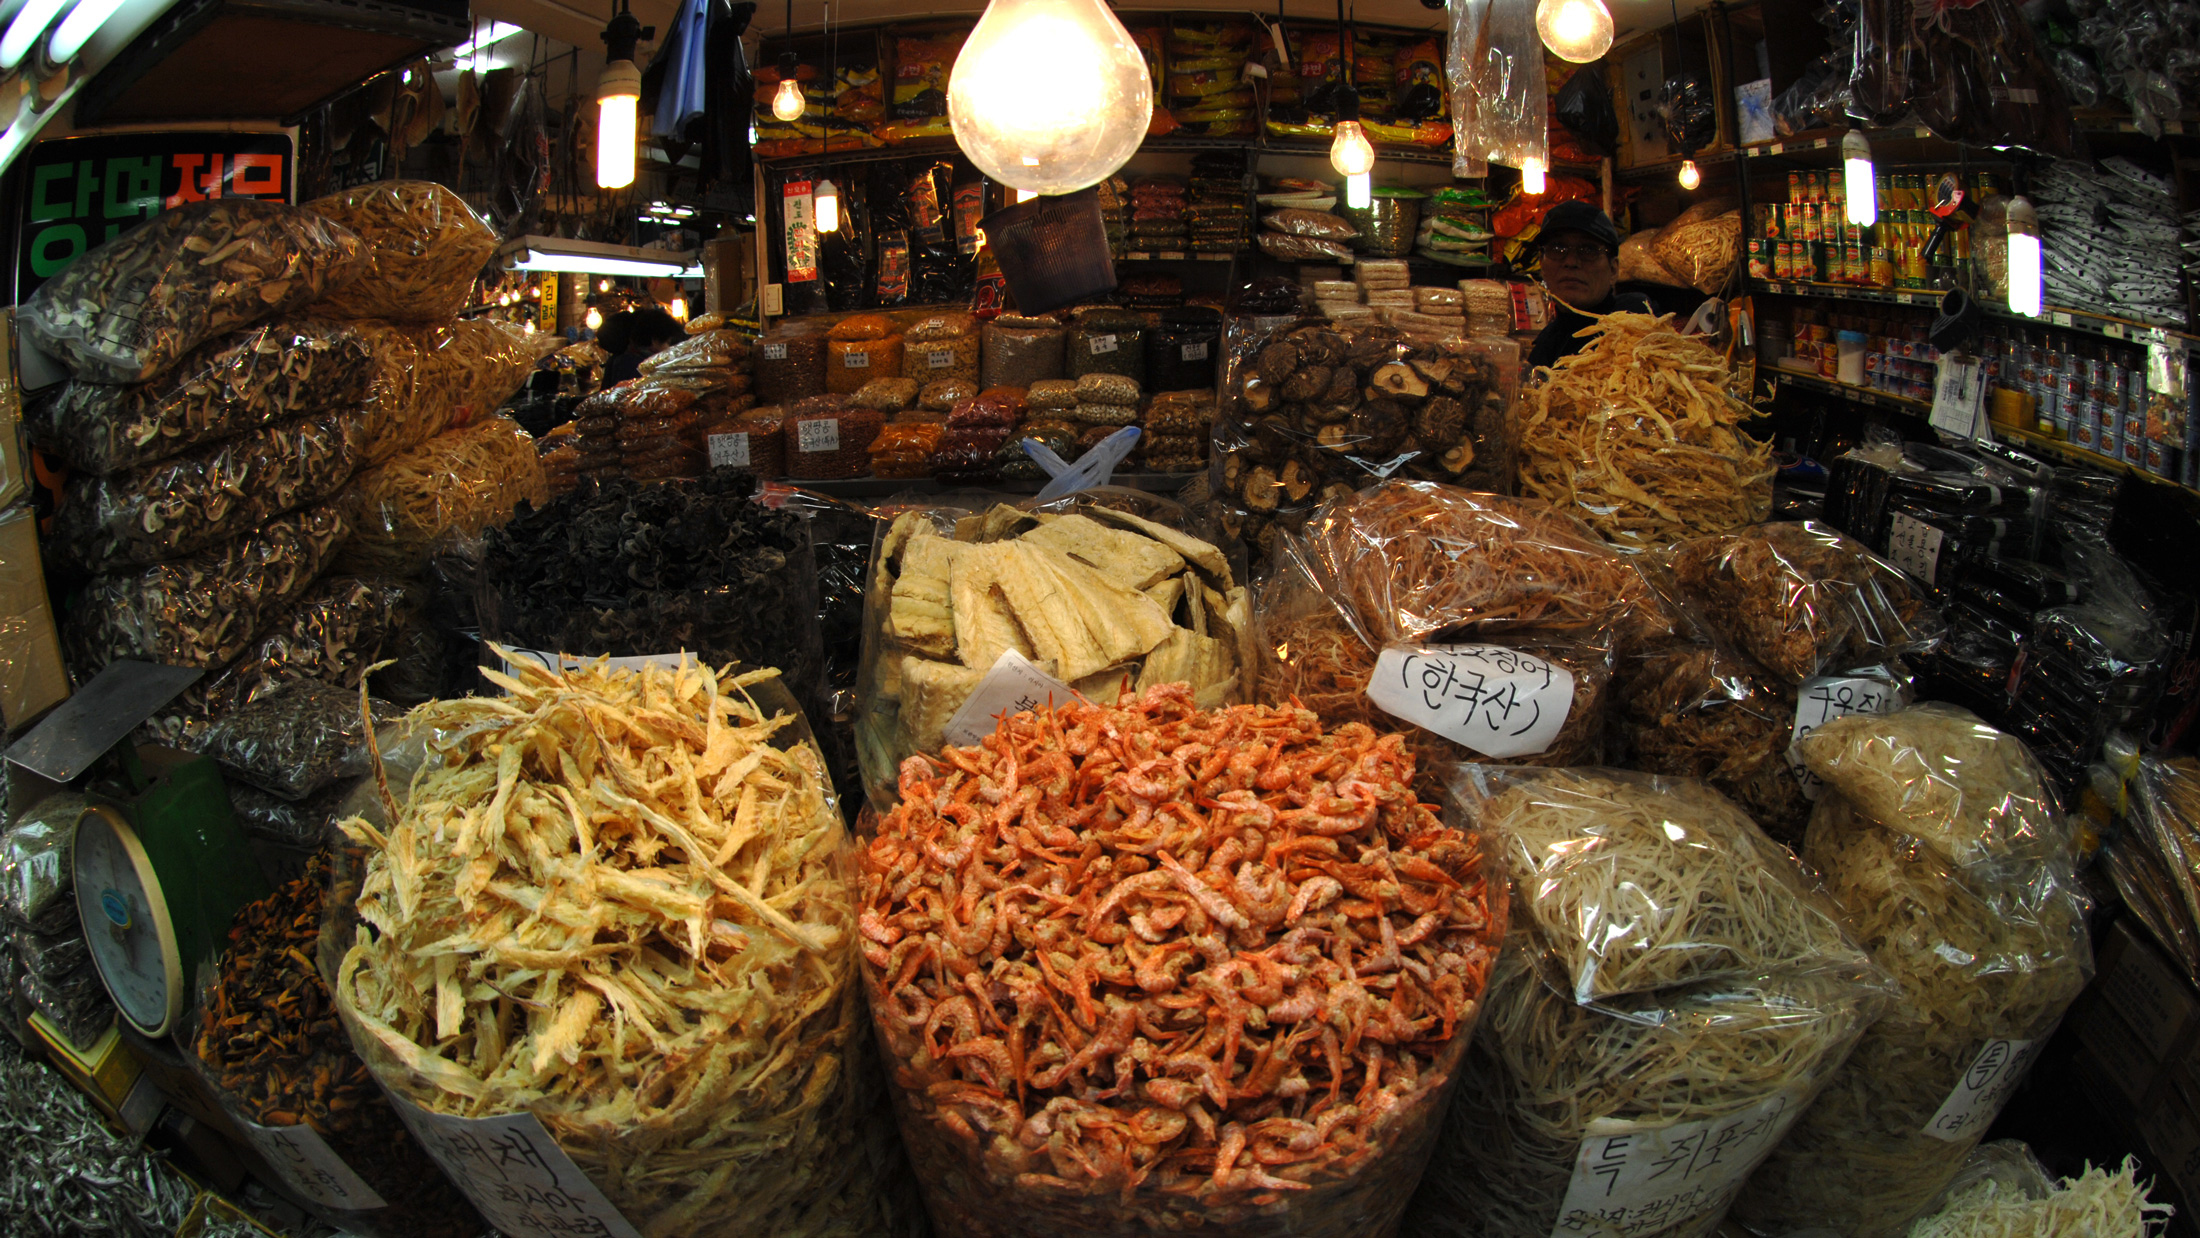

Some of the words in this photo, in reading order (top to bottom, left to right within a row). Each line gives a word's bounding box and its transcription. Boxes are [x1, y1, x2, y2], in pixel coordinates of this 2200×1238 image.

[803, 420, 831, 437] 햇땅콩
[1402, 654, 1540, 737] (한국산)
[1592, 1135, 1633, 1197] 특
[1647, 1096, 1787, 1182] 쥐포채
